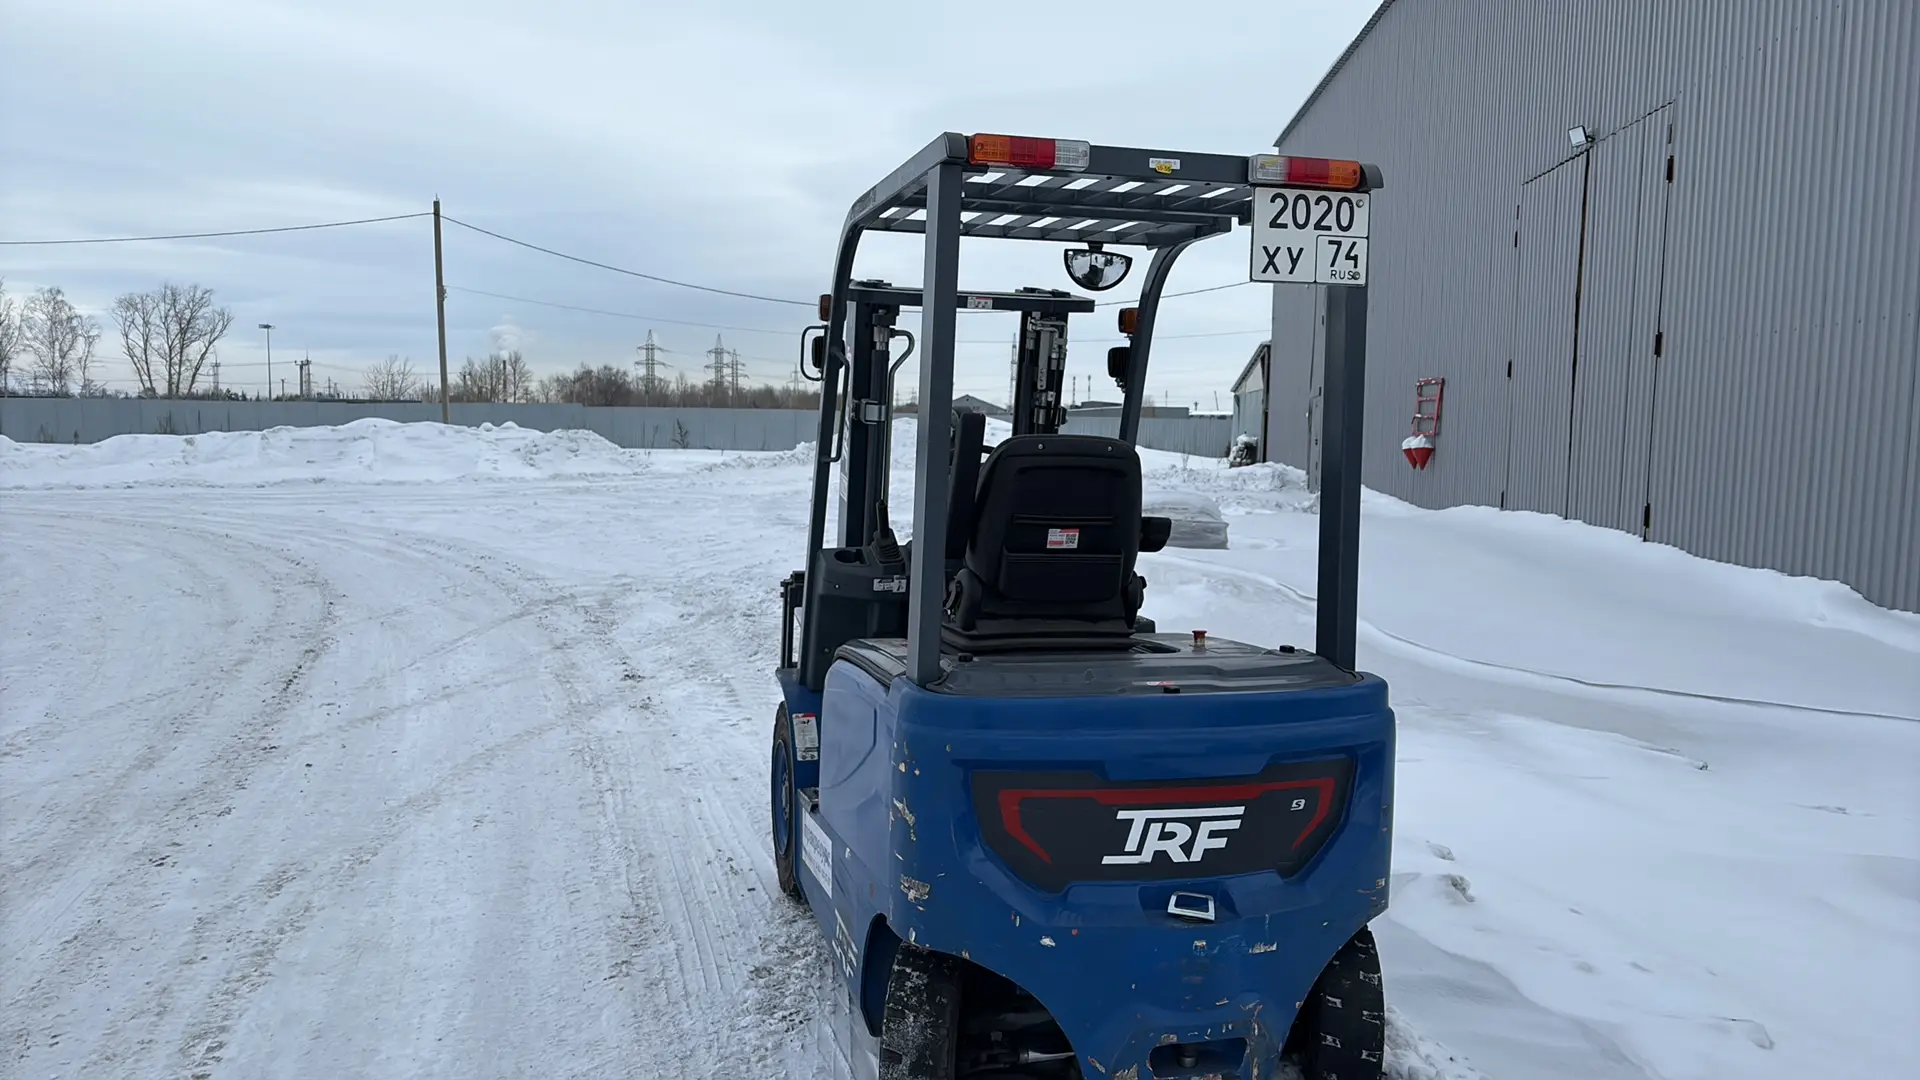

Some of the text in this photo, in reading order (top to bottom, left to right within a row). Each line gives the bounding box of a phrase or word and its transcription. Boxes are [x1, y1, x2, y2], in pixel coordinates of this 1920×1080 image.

[1268, 192, 1355, 232] 2020
[1327, 240, 1359, 269] 74
[1330, 270, 1354, 280] RUS
[1101, 806, 1245, 864] TRF
